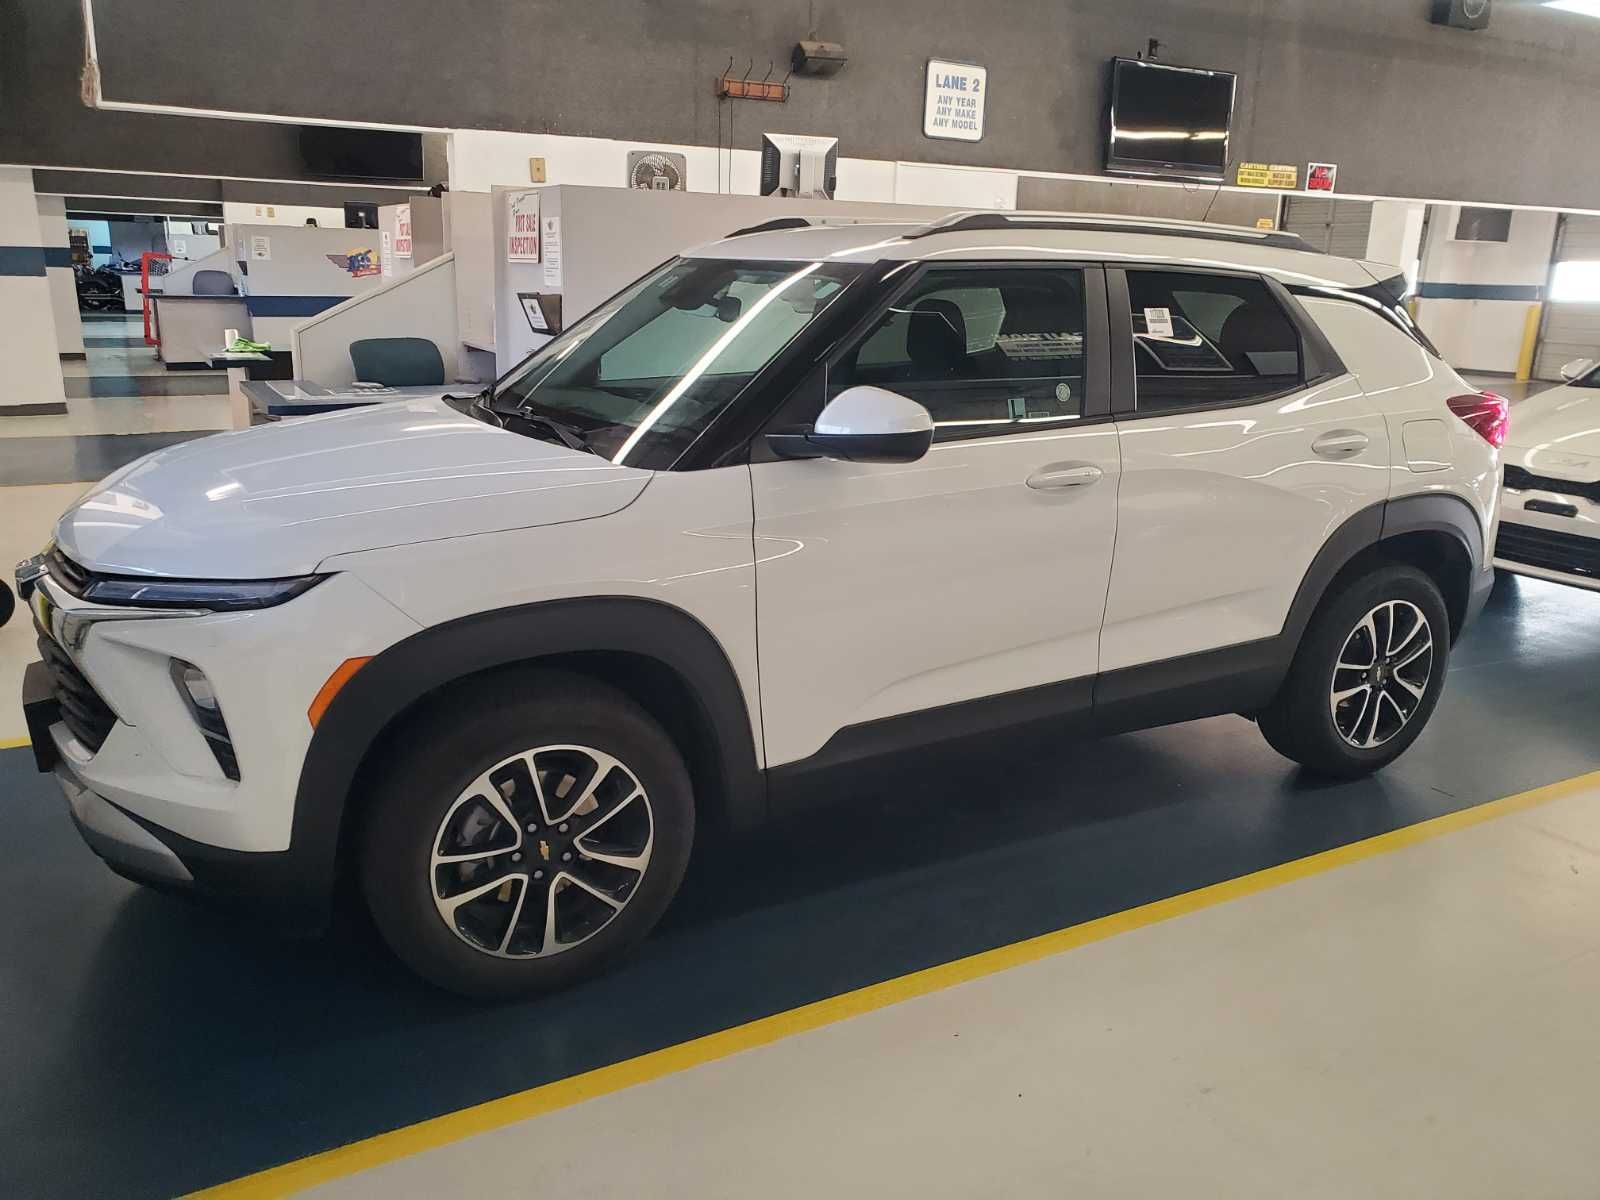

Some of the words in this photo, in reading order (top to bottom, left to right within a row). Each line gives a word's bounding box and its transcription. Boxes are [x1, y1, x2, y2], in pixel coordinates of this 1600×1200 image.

[936, 74, 967, 91] LANE
[973, 79, 980, 92] 2
[937, 95, 953, 106] ANY
[956, 97, 976, 108] YEAR
[936, 106, 952, 117] ANY
[955, 108, 976, 120] MAKE
[933, 117, 951, 128] ANY
[951, 119, 978, 130] MODEL
[509, 236, 537, 255] INSPECTION
